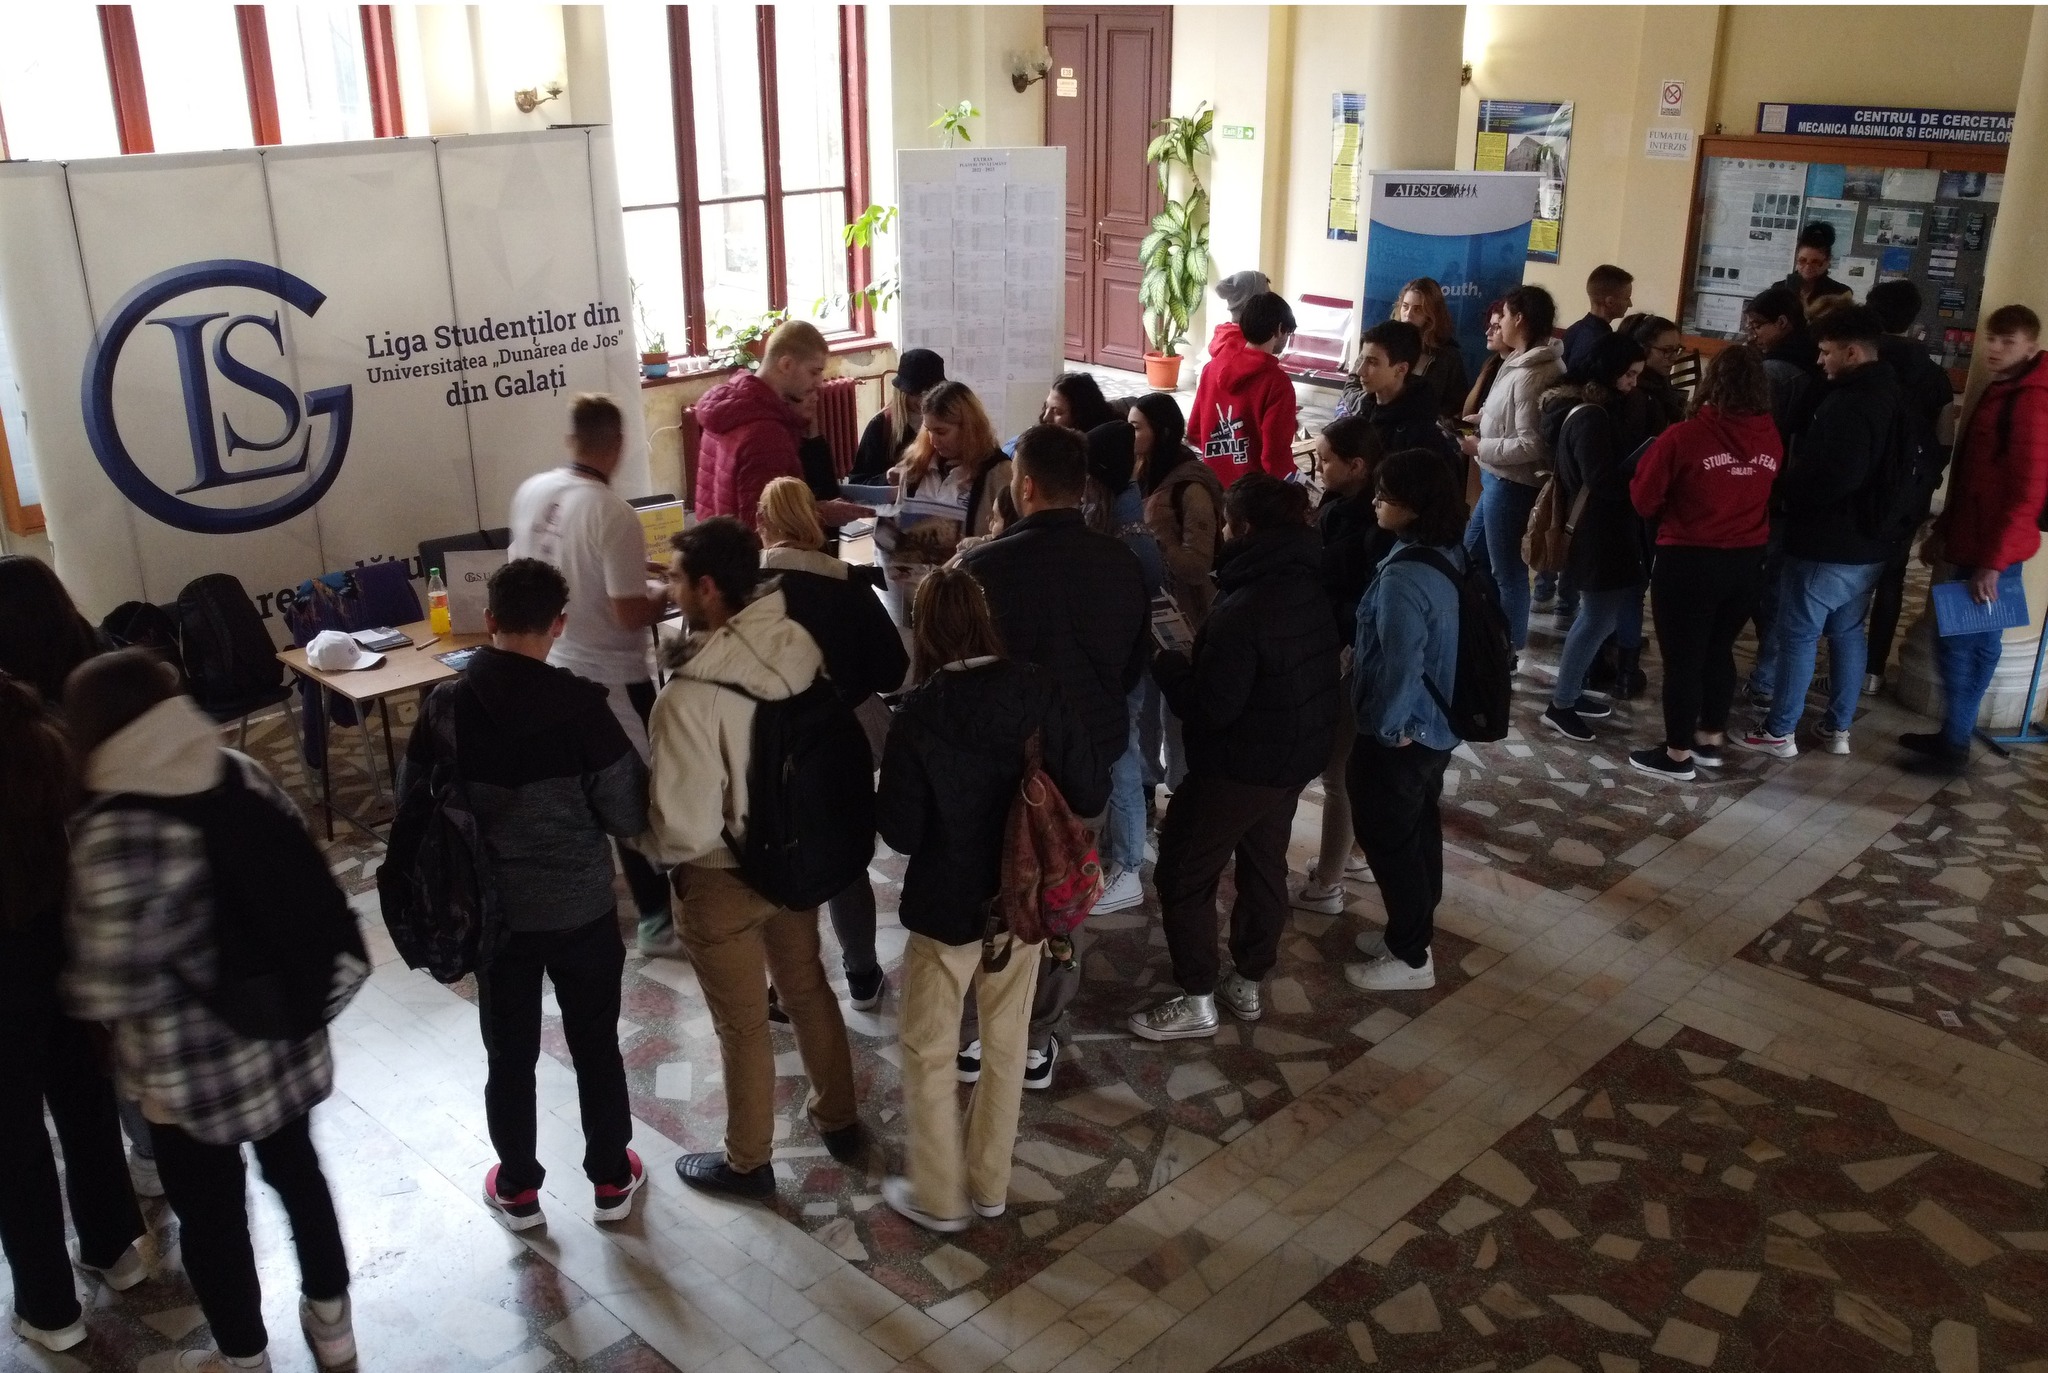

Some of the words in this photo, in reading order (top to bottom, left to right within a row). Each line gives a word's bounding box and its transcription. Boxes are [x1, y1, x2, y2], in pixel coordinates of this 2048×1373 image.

[1854, 110, 1917, 125] CENTRUL
[1920, 113, 1939, 125] DE
[1942, 114, 2015, 129] CERCETAR
[1649, 131, 1688, 141] FUMATUL
[1797, 121, 1848, 135] MECANICA
[1849, 124, 1904, 138] MASINILOR
[1905, 127, 1917, 138] SI
[1918, 128, 2012, 143] ECHIPAMENTELOR
[1649, 141, 1687, 152] INTERZIS
[1393, 184, 1449, 197] AIESEC
[1441, 281, 1482, 298] outh,
[365, 331, 428, 361] Liga
[583, 302, 621, 328] din
[367, 354, 488, 384] Universitatea
[570, 337, 589, 354] de
[446, 380, 489, 407] din
[1205, 437, 1249, 458] RYLF
[1233, 452, 1248, 464] 22
[1703, 453, 1740, 470] STUDE
